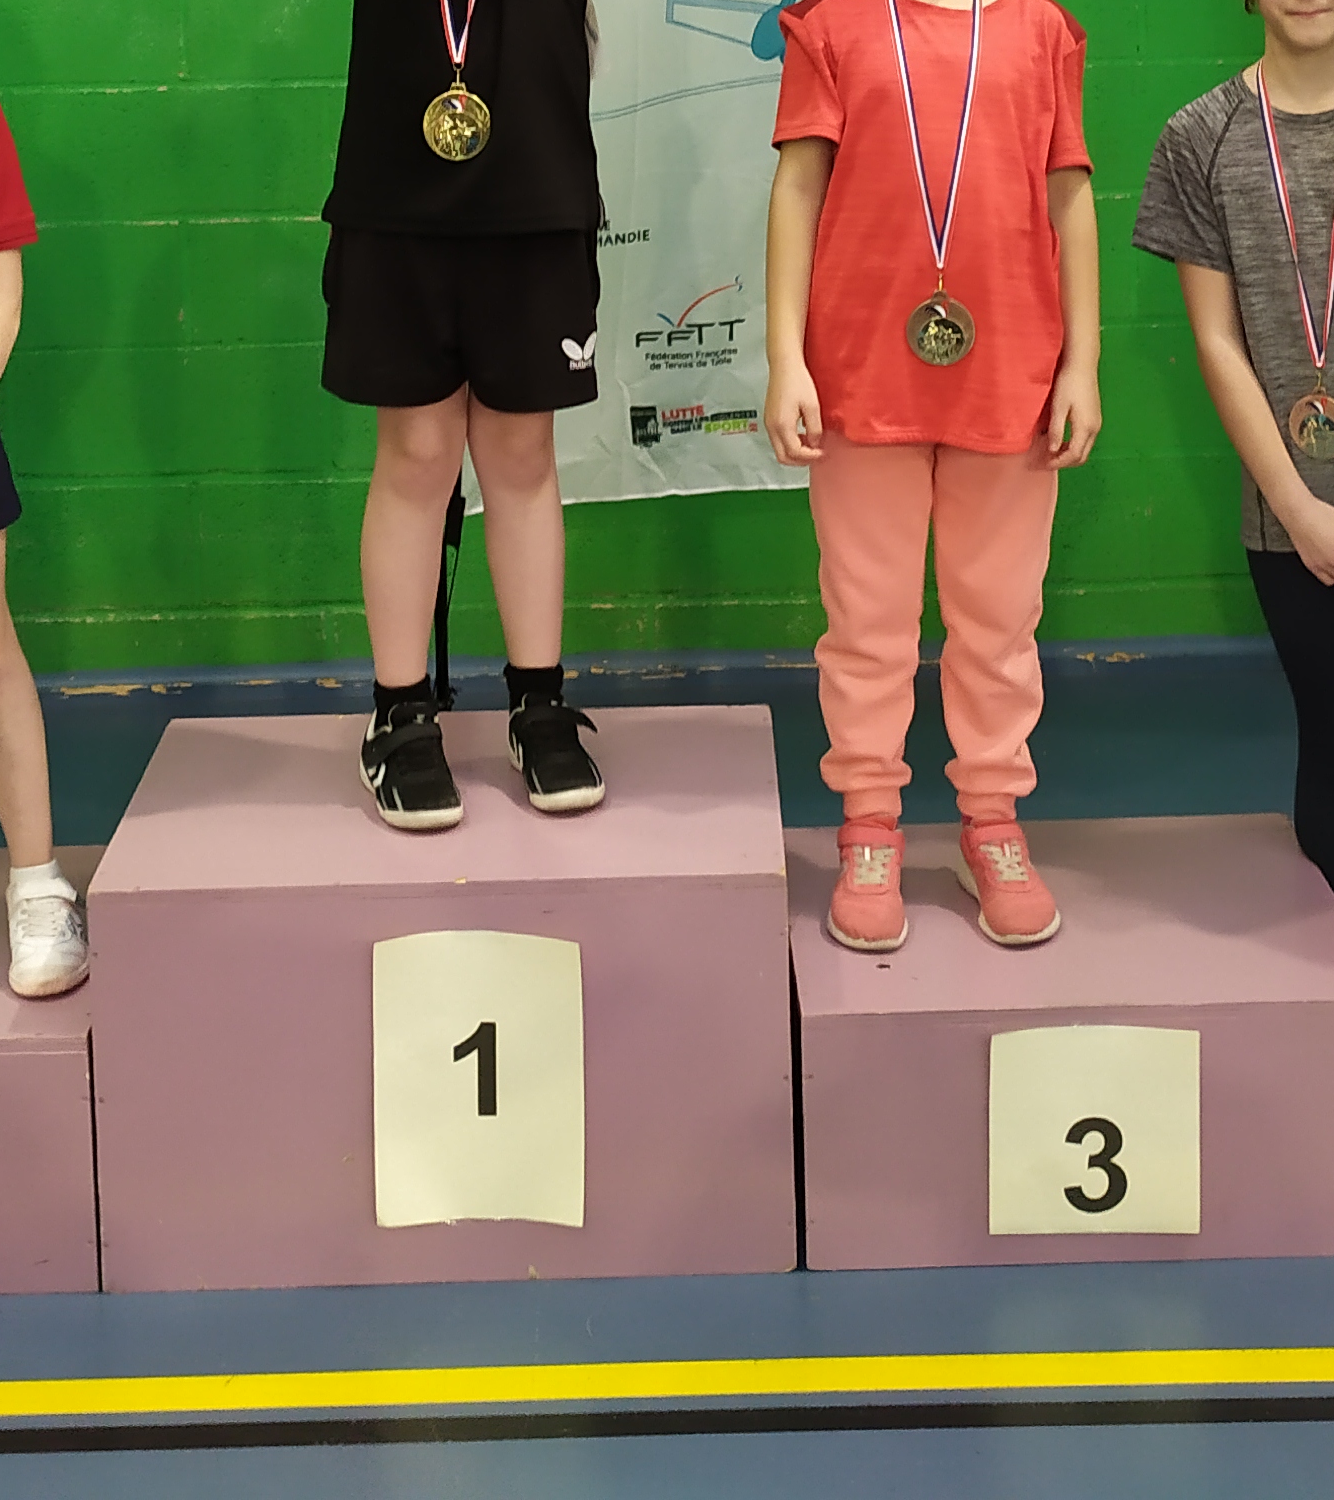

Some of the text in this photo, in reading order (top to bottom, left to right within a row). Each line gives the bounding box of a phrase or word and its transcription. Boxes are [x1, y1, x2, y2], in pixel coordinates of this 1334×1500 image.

[635, 318, 746, 348] FFTT
[649, 362, 661, 371] de
[696, 360, 708, 368] de
[453, 1021, 497, 1116] 1
[1063, 1117, 1128, 1213] 3
